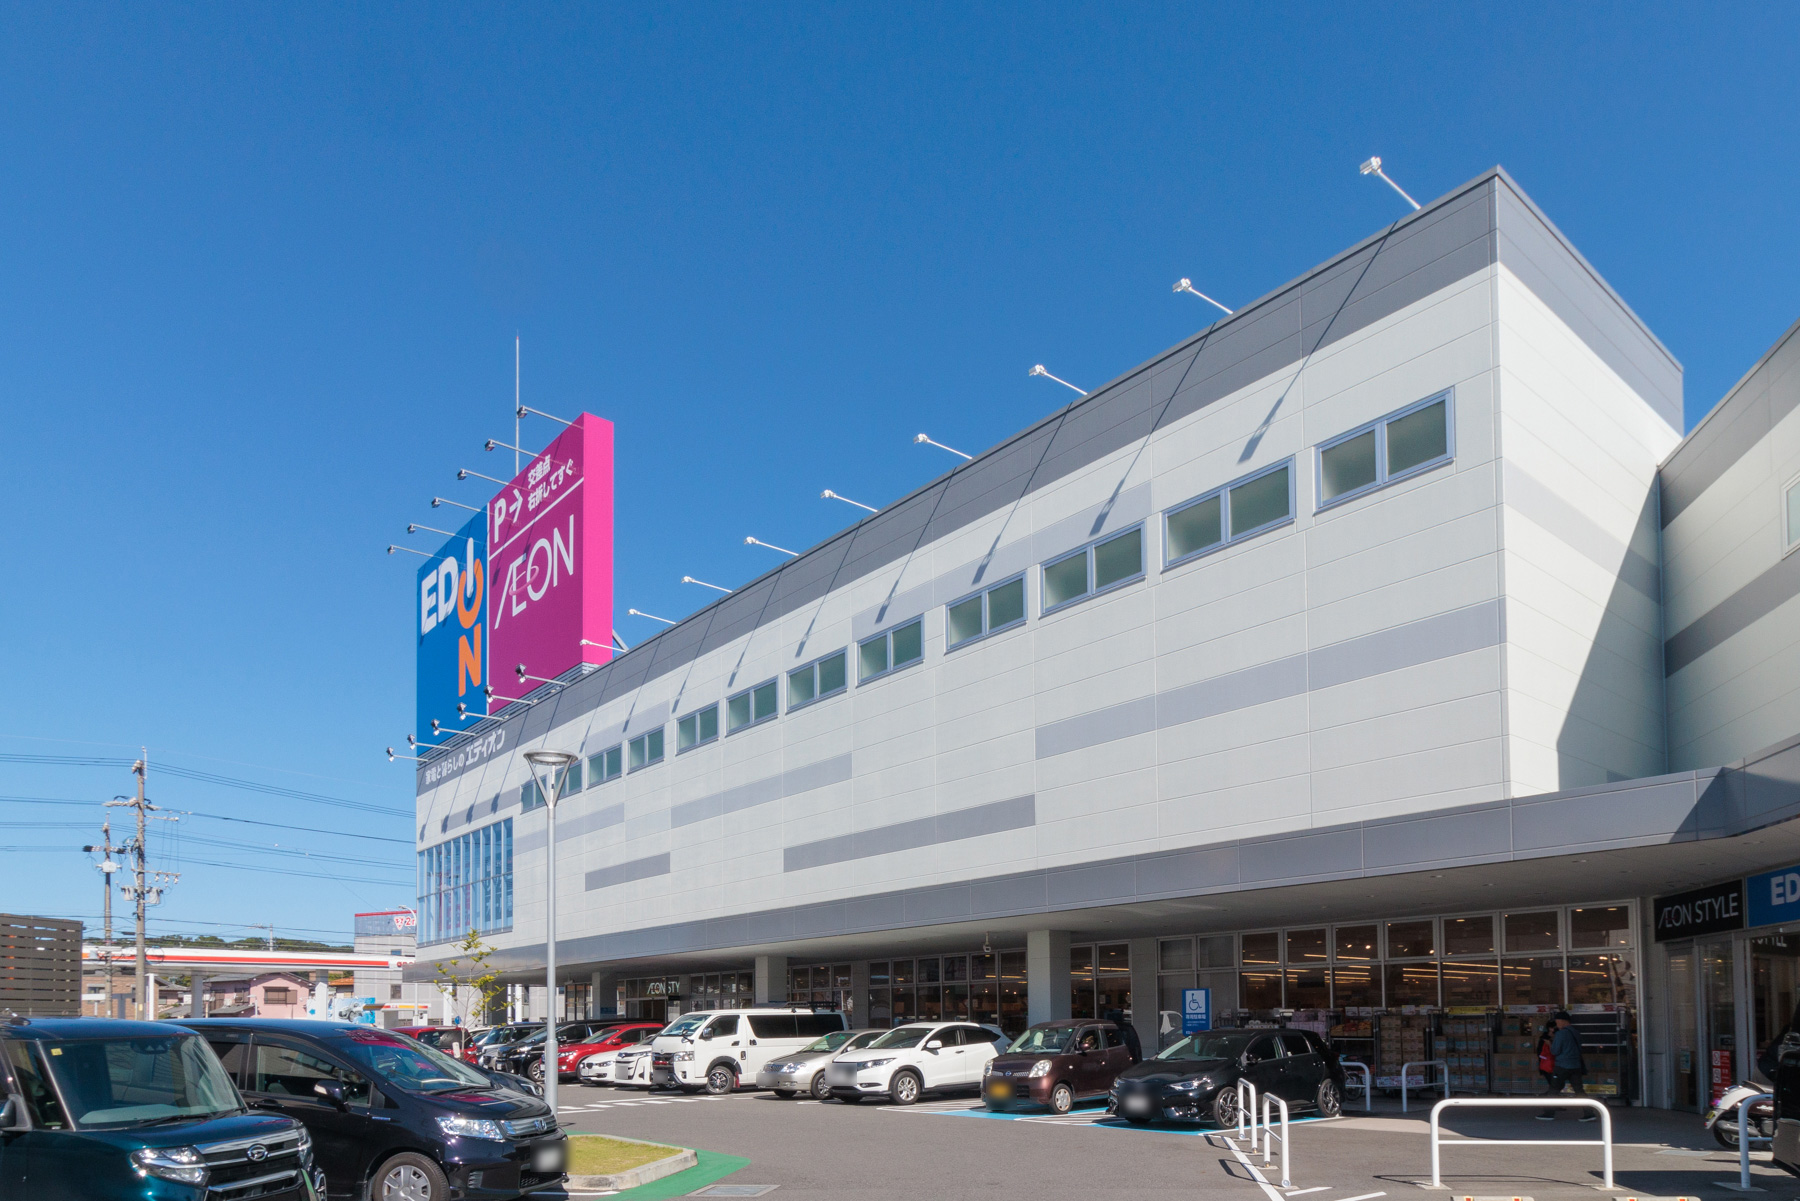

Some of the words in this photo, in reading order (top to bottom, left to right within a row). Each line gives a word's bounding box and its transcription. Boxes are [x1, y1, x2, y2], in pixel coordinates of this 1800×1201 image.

[527, 454, 551, 490] 交差点
[527, 458, 574, 512] 右折してすぐ
[494, 498, 507, 543] P
[1694, 892, 1739, 923] STYLE
